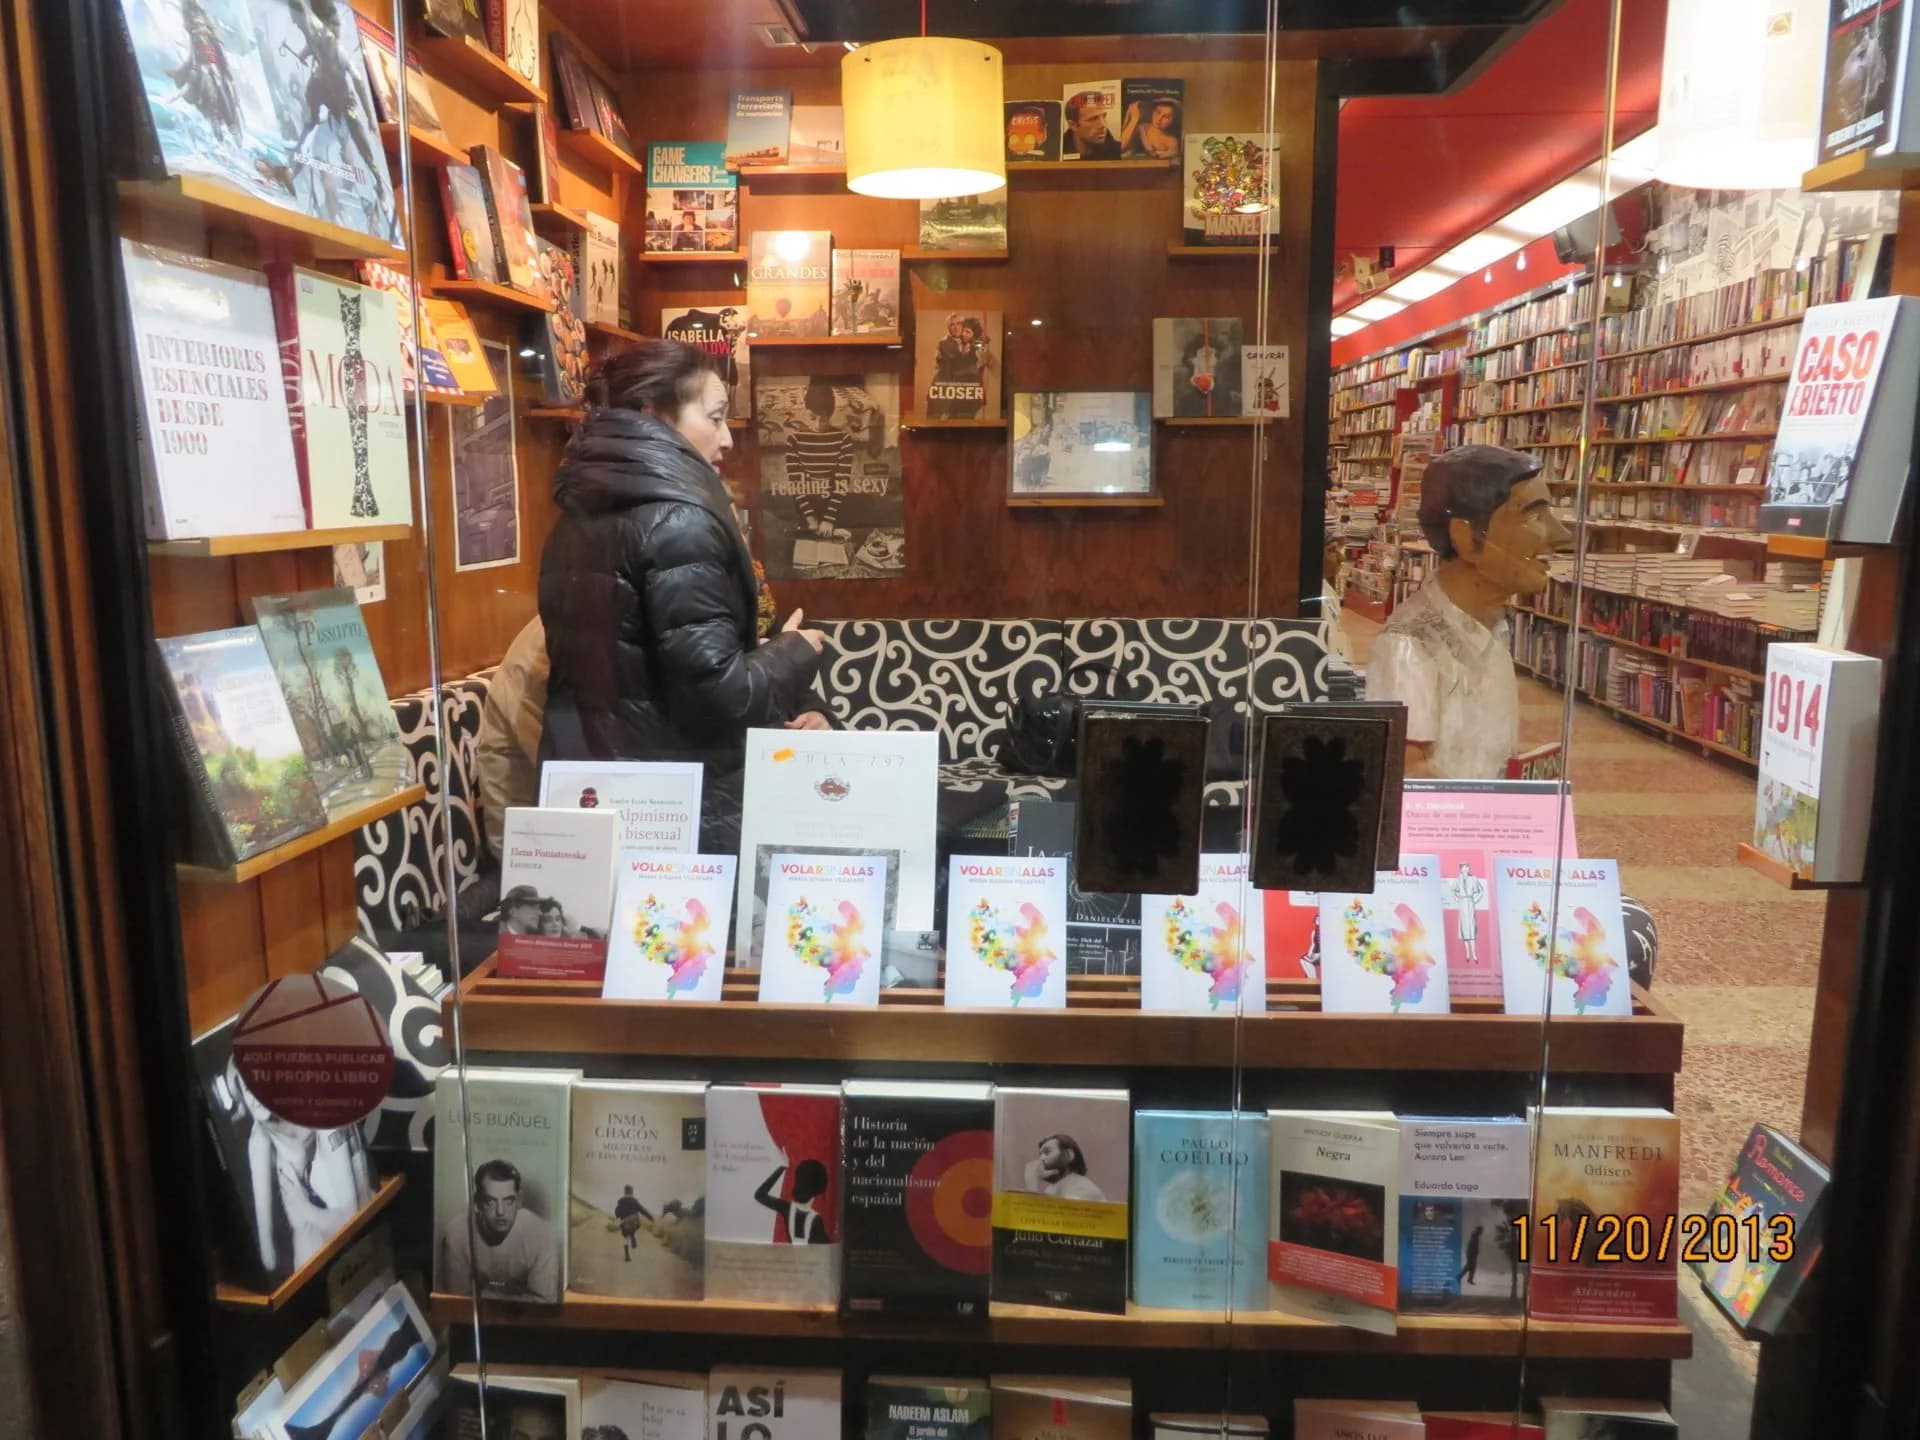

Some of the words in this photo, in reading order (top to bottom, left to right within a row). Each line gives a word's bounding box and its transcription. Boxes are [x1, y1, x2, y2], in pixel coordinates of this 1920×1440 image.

[653, 146, 686, 165] GAME
[652, 165, 711, 184] CHANGERS
[1205, 214, 1261, 236] MARVEL
[751, 267, 827, 280] GRANDES
[667, 328, 725, 343] ISABELLA
[146, 333, 266, 374] INTERIORES
[1798, 329, 1880, 383] CASO
[152, 366, 269, 401] ESENCIALES
[307, 348, 403, 417] MODA
[929, 386, 984, 400] CLOSER
[156, 398, 224, 427] DESDE
[161, 429, 208, 456] 1900
[770, 473, 830, 498] reading
[834, 474, 848, 495] is
[853, 477, 889, 500] sexy
[1767, 671, 1823, 748] 1914
[619, 808, 688, 825] Alpinismo
[625, 827, 681, 841] bisexual
[511, 846, 533, 858] Elena
[275, 1052, 322, 1064] PUEDES
[325, 1052, 386, 1064] PUBLICAR
[253, 1069, 272, 1082] TU
[275, 1069, 330, 1083] PROPIO
[335, 1070, 379, 1083] LIBRO
[487, 1111, 552, 1130] BUÑUEL
[608, 1113, 647, 1128] INMA
[854, 1116, 908, 1131] Historia
[1414, 1128, 1453, 1140] Siempre
[1455, 1131, 1476, 1140] supe
[853, 1135, 869, 1149] de
[874, 1135, 886, 1149] la
[891, 1137, 935, 1151] nación
[1182, 1138, 1229, 1150] PAULO
[1414, 1142, 1432, 1151] que
[1161, 1151, 1249, 1167] COELHO
[1316, 1145, 1351, 1162] Negra
[1414, 1152, 1447, 1161] Aurora
[1554, 1143, 1664, 1161] MANFREDI
[852, 1158, 858, 1170] y
[865, 1153, 885, 1168] del
[1584, 1164, 1631, 1177] Odiseo
[852, 1174, 941, 1189] nacionalismo
[1414, 1180, 1453, 1190] Eduardo
[1456, 1182, 1479, 1192] Lago
[852, 1191, 902, 1209] español
[715, 1378, 785, 1418] ASÍ
[888, 1404, 931, 1421] NADEEM
[933, 1406, 969, 1424] ASLAM
